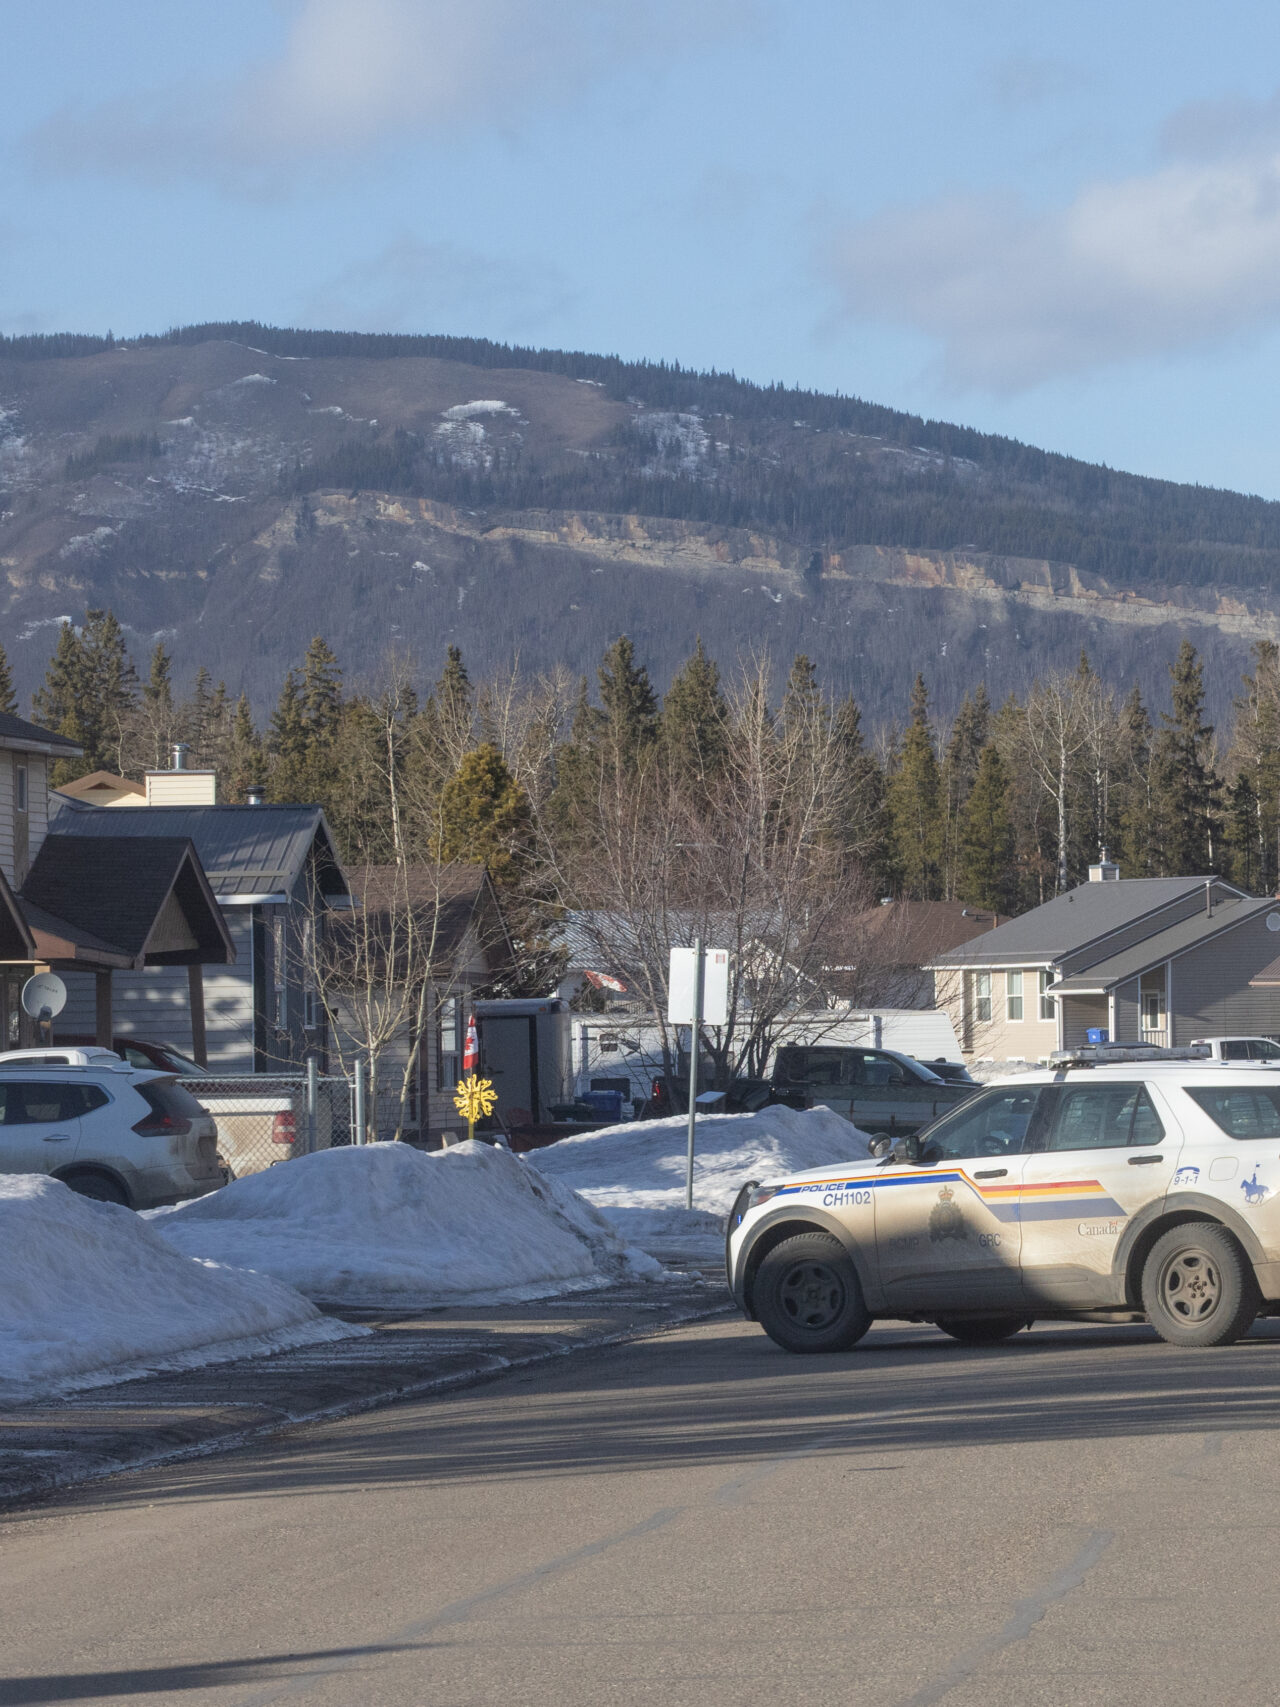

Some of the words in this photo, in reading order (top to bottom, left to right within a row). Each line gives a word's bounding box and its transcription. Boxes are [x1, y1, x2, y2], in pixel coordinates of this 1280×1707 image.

[801, 1183, 845, 1192] POLICE
[1174, 1176, 1198, 1185] 9-1-1
[823, 1191, 871, 1206] CH1102
[1077, 1222, 1118, 1236] Canada
[979, 1233, 1001, 1247] GRC
